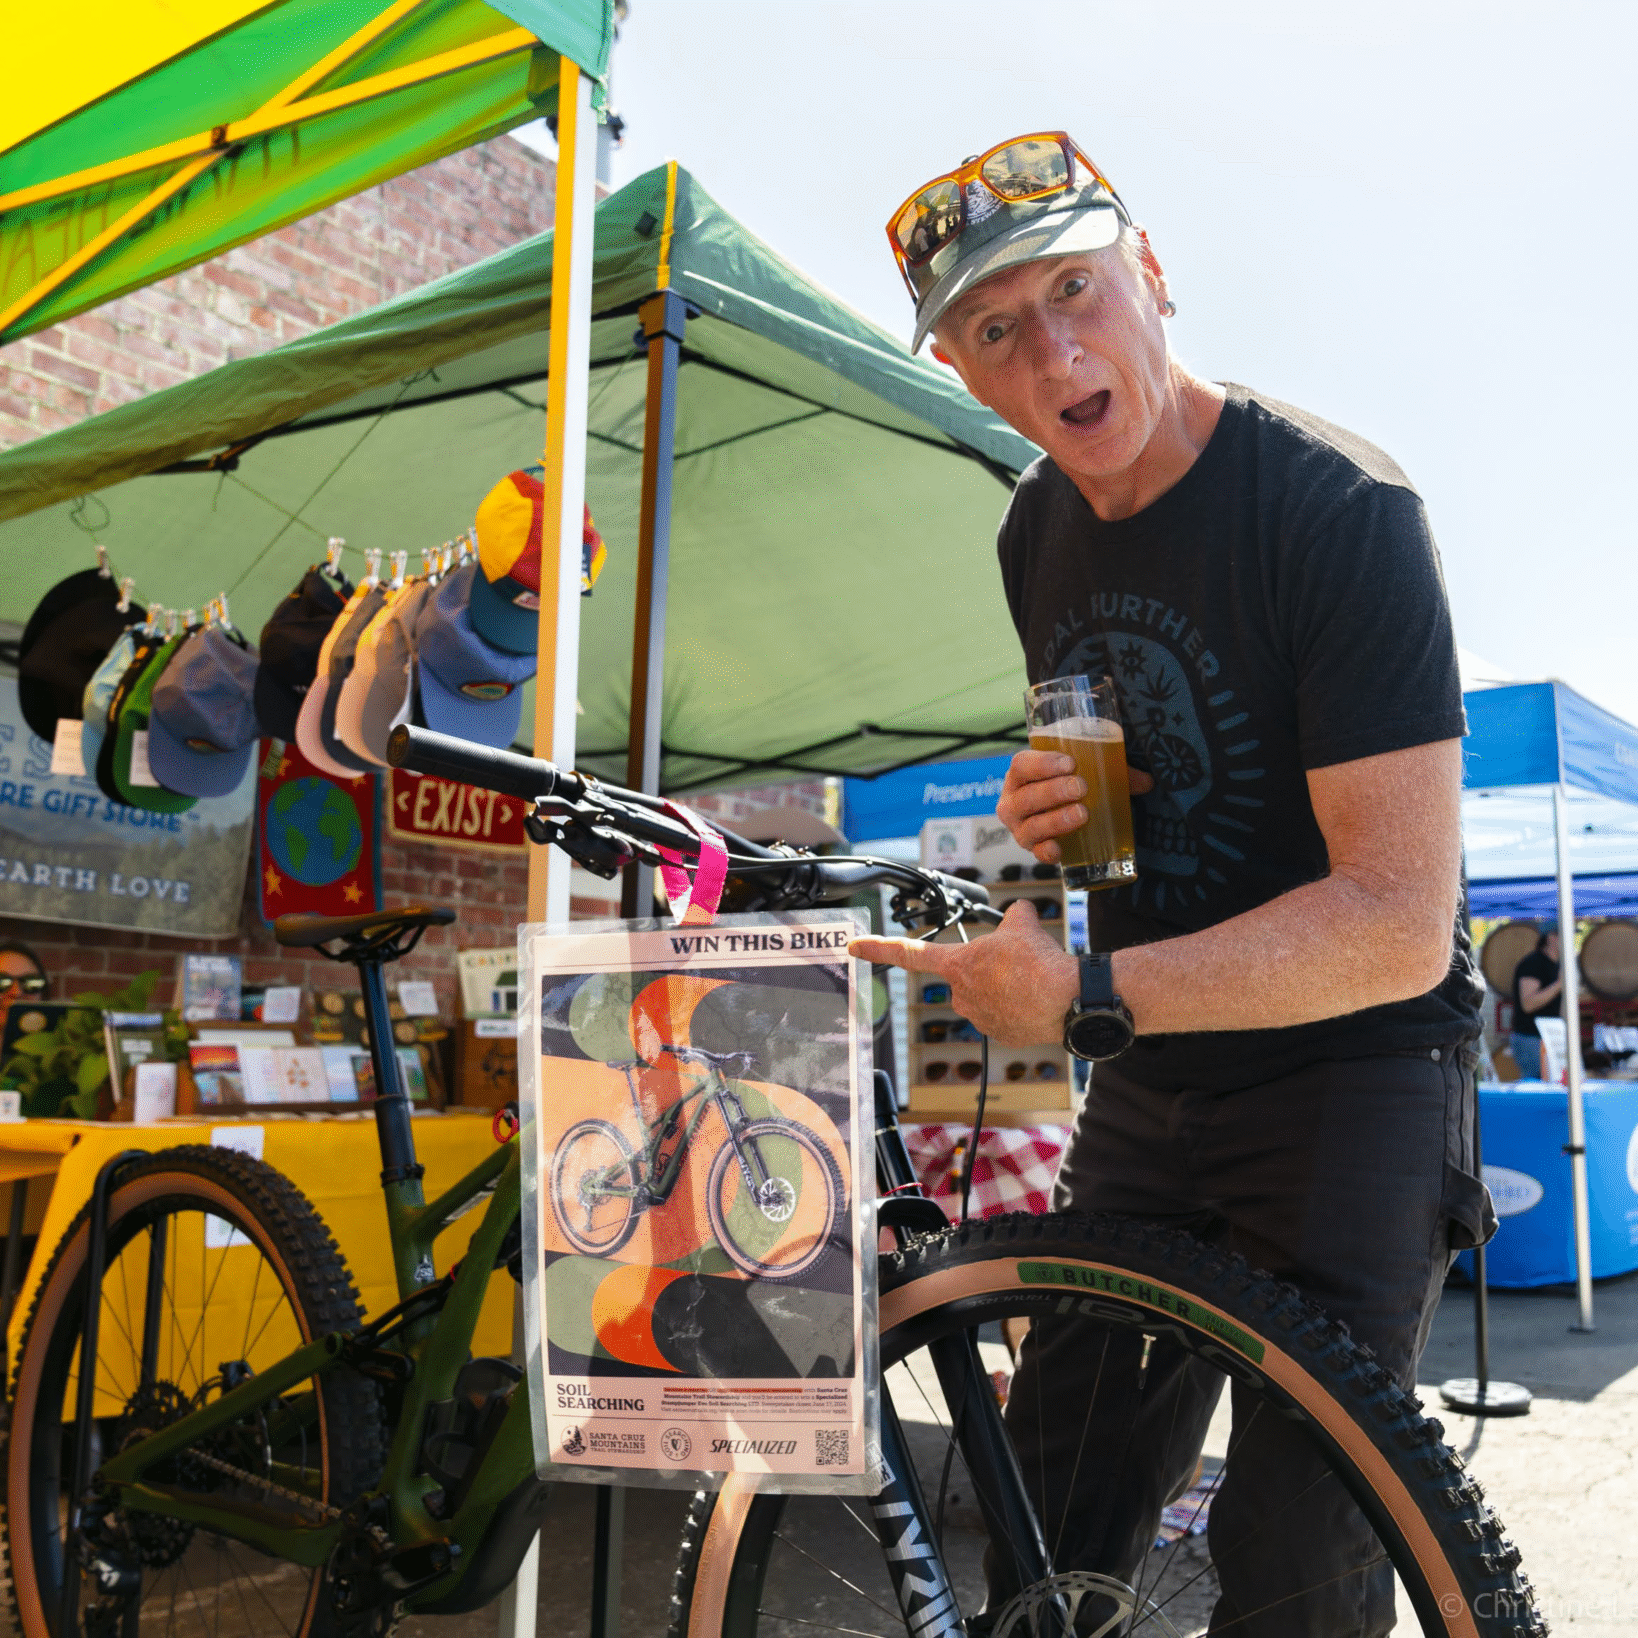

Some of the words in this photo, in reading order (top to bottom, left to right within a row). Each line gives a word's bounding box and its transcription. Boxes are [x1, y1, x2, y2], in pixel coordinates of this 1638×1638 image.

[43, 790, 101, 818] GIFT
[412, 779, 502, 837] EXIST
[110, 873, 190, 903] LOVE
[671, 935, 720, 954] WIN
[725, 933, 784, 952] THIS
[790, 930, 848, 950] BIKE
[1062, 1267, 1191, 1319] BUTCHER
[556, 1383, 592, 1396] SOIL
[557, 1396, 645, 1411] SEARCHING
[589, 1432, 618, 1440] SANTA
[620, 1434, 645, 1442] CRUZ
[590, 1440, 646, 1449] MOUNTAINS
[709, 1439, 798, 1454] SPECIALIZED
